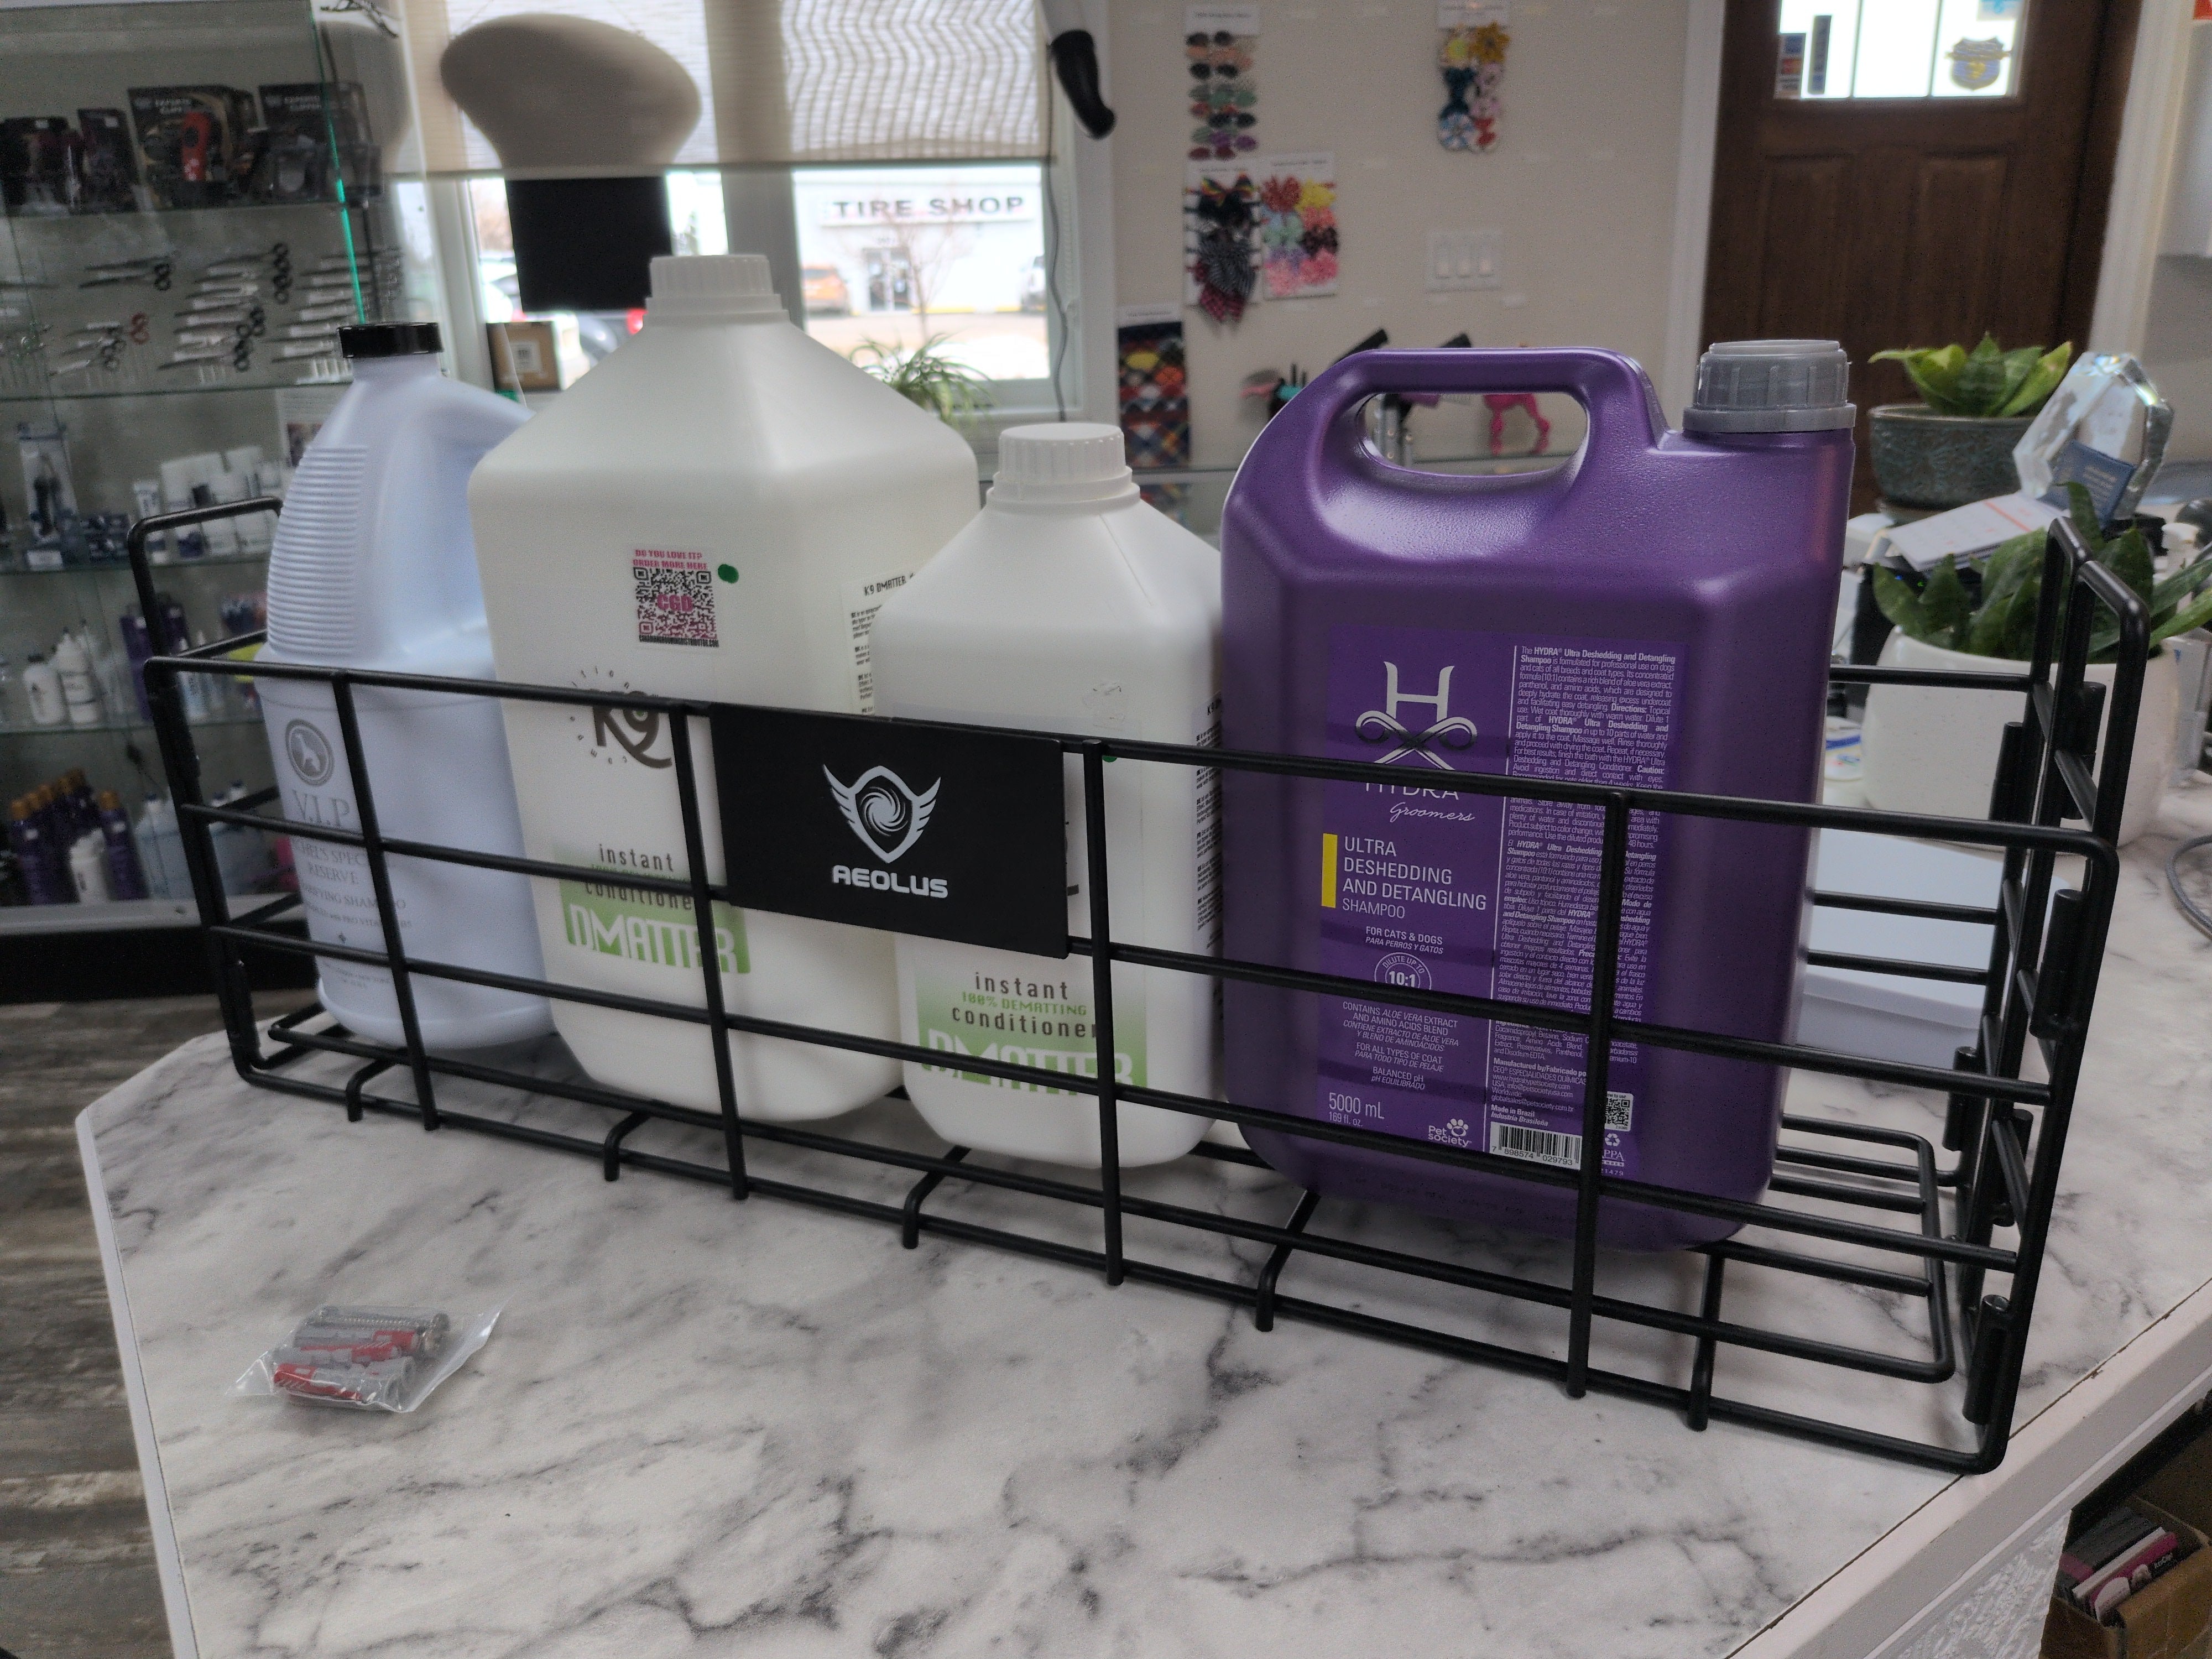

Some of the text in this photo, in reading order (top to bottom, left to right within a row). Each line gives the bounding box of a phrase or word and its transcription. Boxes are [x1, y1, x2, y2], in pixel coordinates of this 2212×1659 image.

[833, 197, 1024, 217] TIRE SHOP
[864, 585, 874, 596] K9
[658, 594, 693, 612] CGD
[1521, 655, 1552, 664] Shampoo
[1559, 658, 1590, 667] formulated
[1592, 660, 1600, 668] for
[1601, 661, 1637, 671] professional
[1650, 664, 1658, 672] on
[1659, 665, 1674, 674] dogs
[1522, 645, 1532, 654] The
[1564, 649, 1580, 658] Ultra
[1582, 650, 1622, 661] Deshedding
[1623, 653, 1637, 662] and
[1637, 654, 1676, 665] Detangling
[1558, 675, 1582, 683] contains
[1561, 666, 1580, 675] breeds
[1635, 672, 1673, 681] concentrated
[1518, 688, 1537, 697] deeply
[1539, 690, 1560, 699] hydrate
[1590, 694, 1617, 703] releasing
[1619, 696, 1639, 705] excess
[1641, 698, 1671, 707] undercoat
[1563, 684, 1582, 692] amino
[1603, 686, 1621, 695] which
[1635, 689, 1663, 698] designed
[1390, 802, 1475, 823] Groomers
[1344, 835, 1397, 857] ULTRA
[598, 843, 674, 872] instant
[1343, 856, 1452, 885] DESHEDDING
[832, 864, 948, 899] AEOLUS
[585, 879, 693, 910] conditione
[1342, 877, 1487, 911] AND DETANGLING
[1342, 897, 1406, 919] SHAMPOO
[1365, 925, 1443, 945] FOR CATS & DOGS
[1365, 936, 1384, 946] PARA
[1385, 939, 1412, 950] PERROS
[1419, 944, 1444, 954] GATOS
[1382, 953, 1426, 975] DILUTE UP TO
[975, 972, 1068, 1000] instant
[1388, 970, 1416, 988] 10:1
[962, 991, 1087, 1016] 100% DEMATTING
[1342, 1000, 1458, 1028] CONTAINS ALOE VERA EXTRACT
[1353, 1011, 1448, 1036] AND AMINO ACIDS BLEND
[1343, 1019, 1459, 1047] CONTIENE EXTRACTO DE ALOE VERA
[1357, 1029, 1361, 1037] Y
[1362, 1030, 1384, 1041] BLEND
[1384, 1034, 1394, 1043] DE
[1354, 1050, 1444, 1073] PARA TODO TIPO DE PELAJE
[1355, 1041, 1442, 1065] FOR ALL TYPES OF COAT
[1372, 1066, 1424, 1083] BALANCED pH
[1493, 1057, 1537, 1070] Manufactured
[1536, 1063, 1578, 1076] by/Fabricado
[1508, 1067, 1557, 1081] ESPECIALIDADES
[1371, 1074, 1426, 1090] pH EQUILIBRADO
[1328, 1092, 1385, 1120] 5000 mL
[1490, 1103, 1509, 1113] Made
[1516, 1109, 1535, 1118] Brazil
[1328, 1111, 1342, 1123] 169
[1490, 1111, 1518, 1122] Industria
[1427, 1131, 1469, 1148] society
[1428, 1124, 1447, 1136] Pet
[1504, 1148, 1533, 1159] 898574
[1542, 1155, 1573, 1166] 029793
